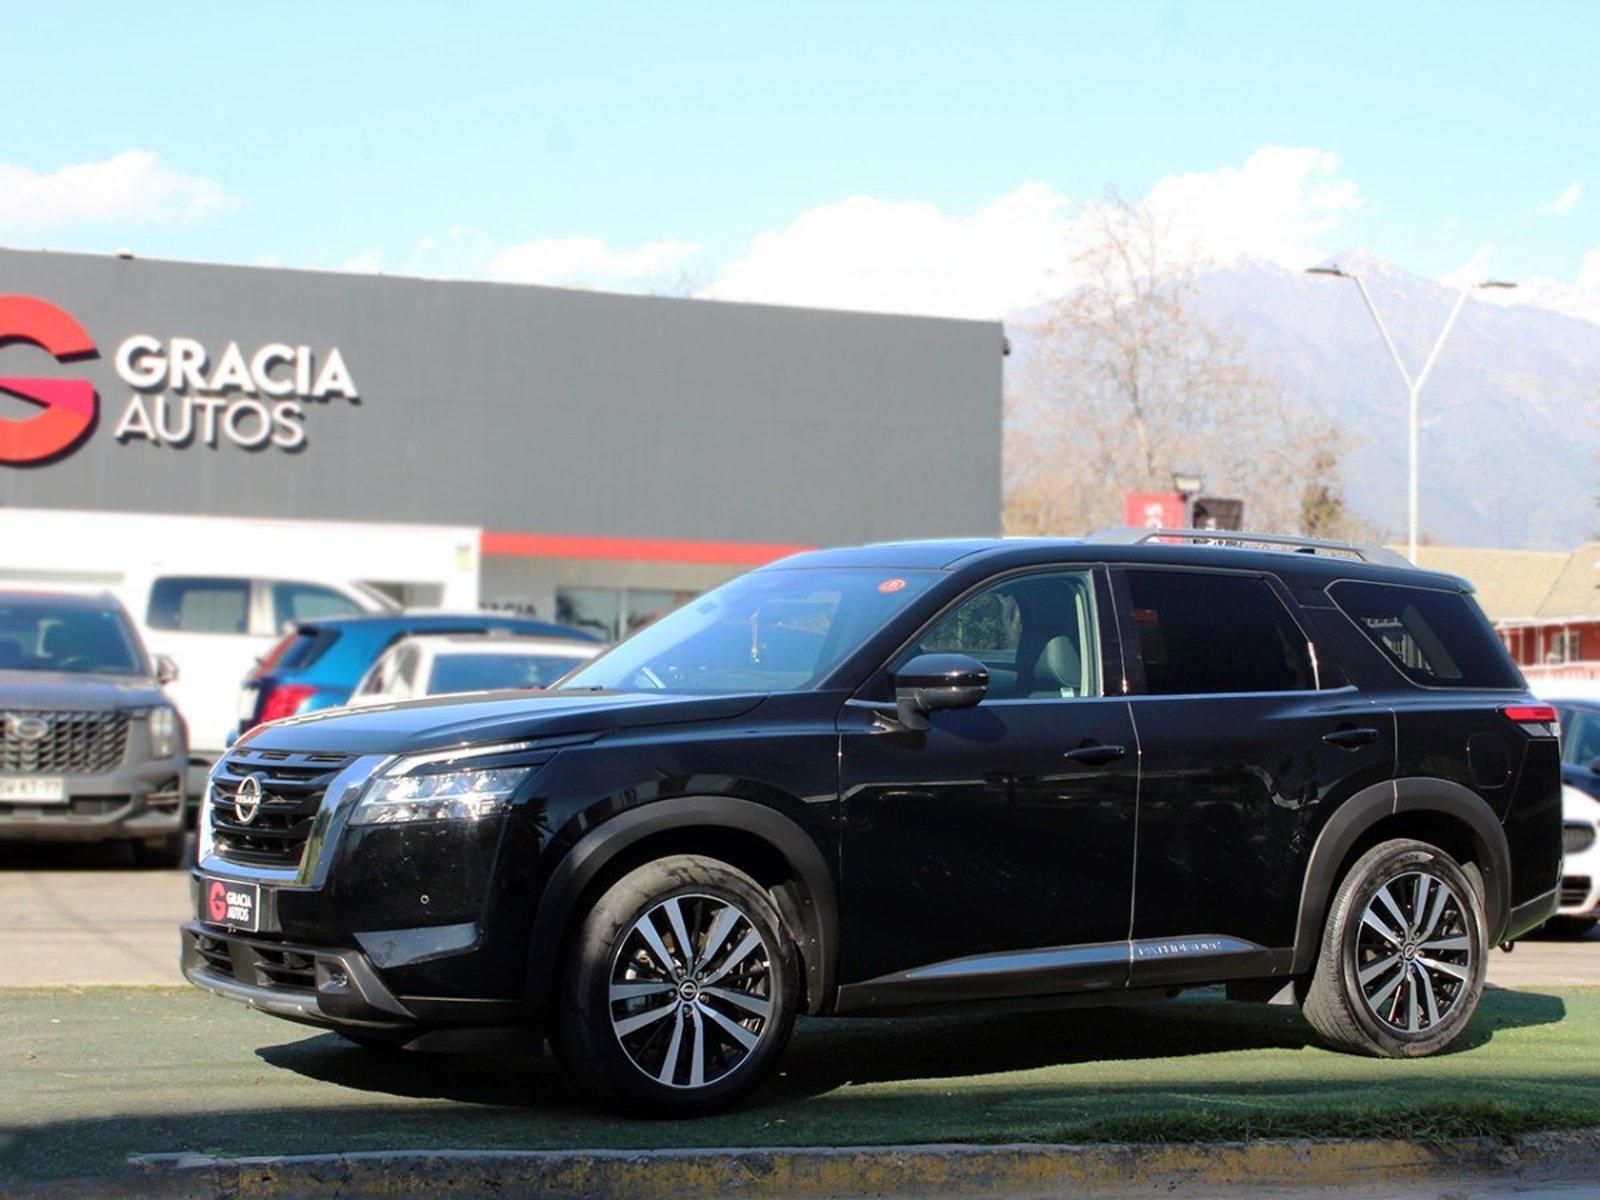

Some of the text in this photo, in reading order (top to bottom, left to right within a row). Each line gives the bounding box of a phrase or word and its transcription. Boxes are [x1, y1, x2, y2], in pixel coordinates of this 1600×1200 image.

[114, 334, 359, 400] GRACIA
[114, 394, 306, 448] AUTOS
[226, 891, 252, 908] GRACIA
[227, 906, 249, 921] AUTOS
